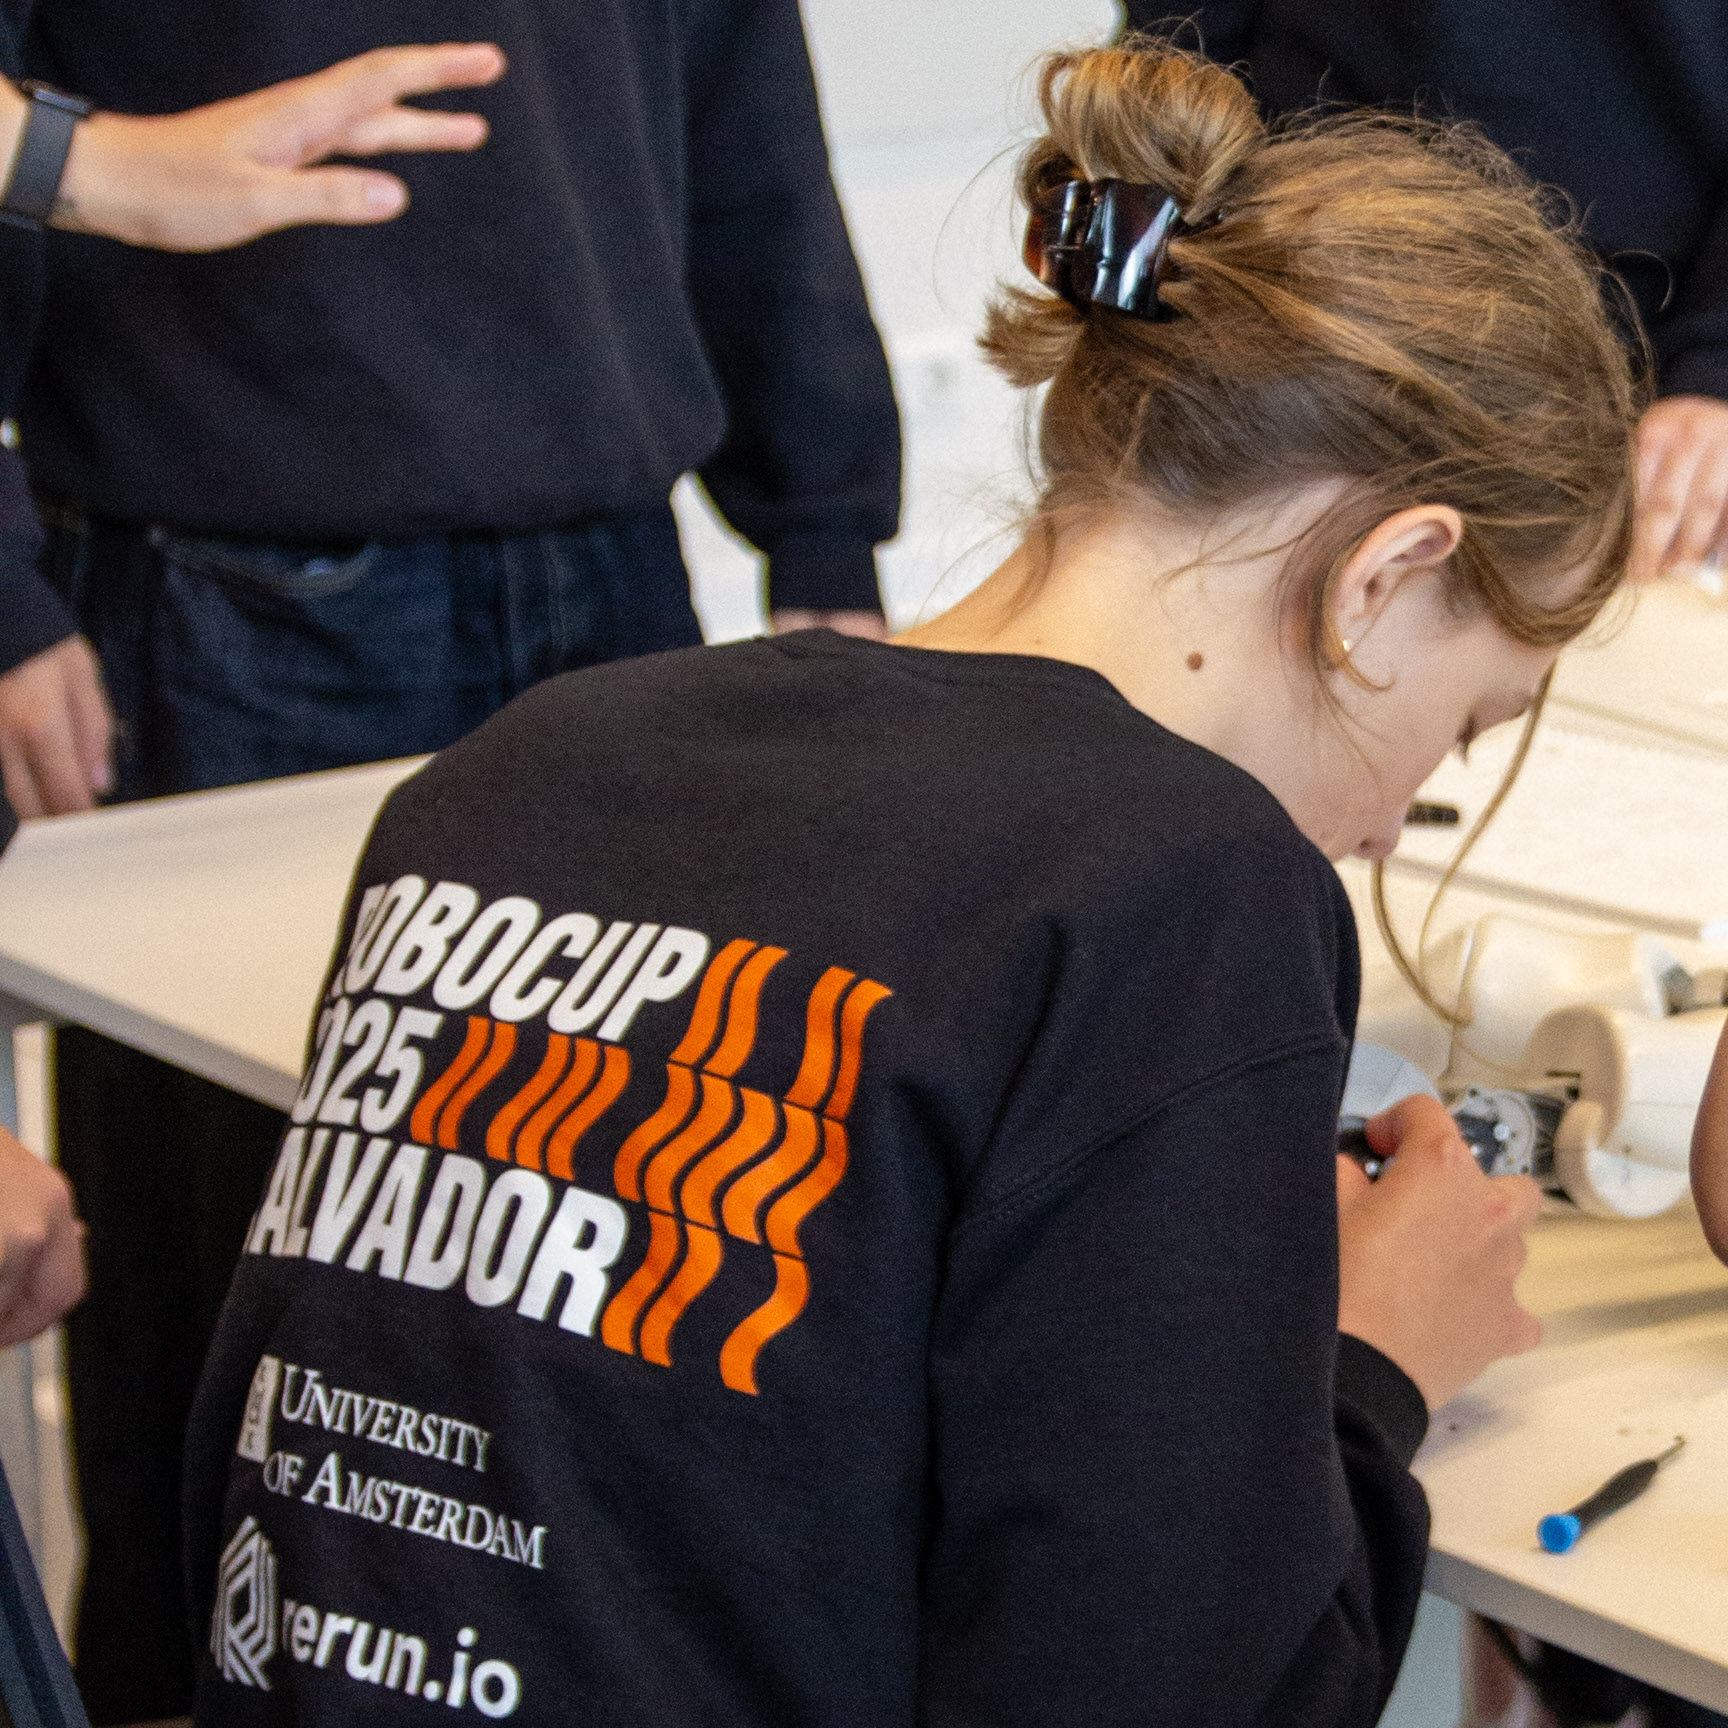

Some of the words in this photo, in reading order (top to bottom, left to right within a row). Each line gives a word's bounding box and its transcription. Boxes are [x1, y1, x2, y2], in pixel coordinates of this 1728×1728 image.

[290, 996, 446, 1134] 025
[242, 1126, 631, 1339] ALVADOR
[262, 1449, 305, 1498] OF
[281, 1597, 522, 1719] rerun.io
